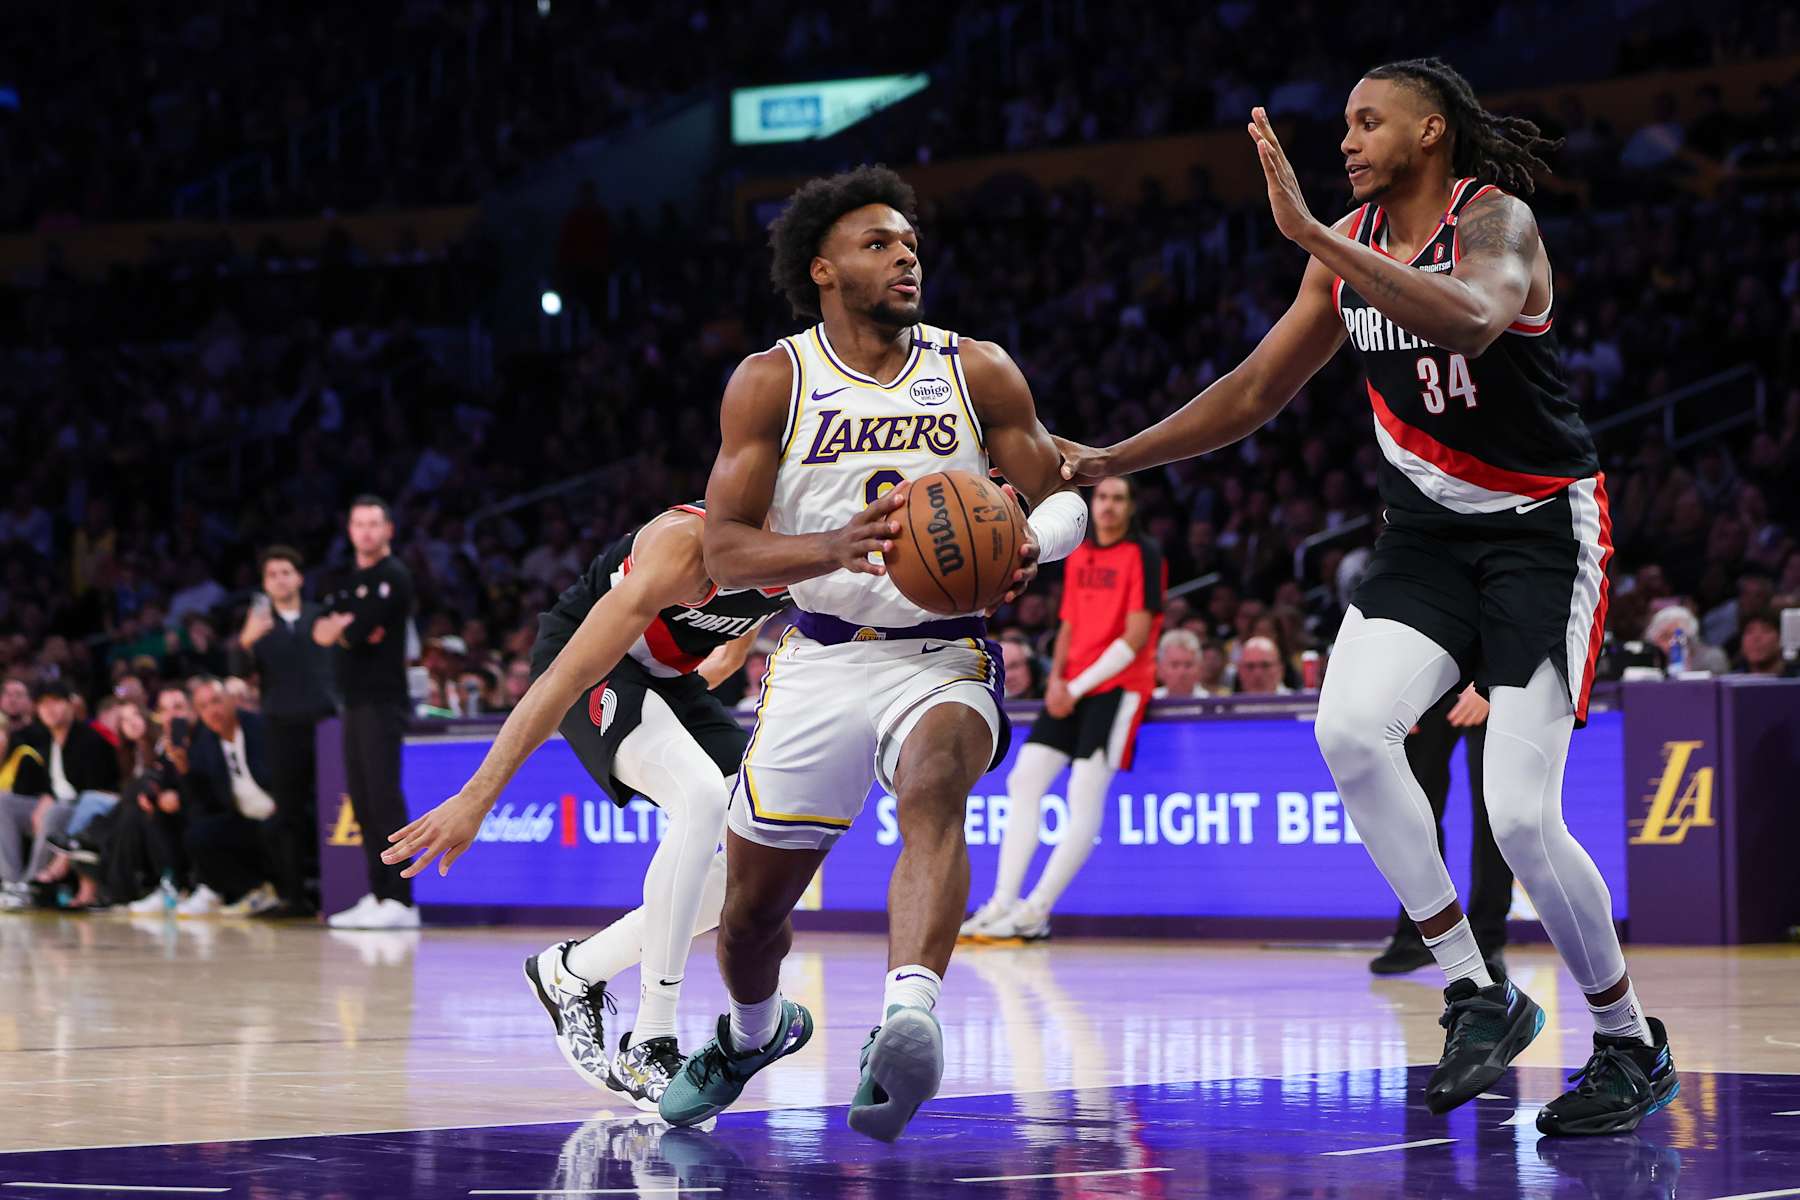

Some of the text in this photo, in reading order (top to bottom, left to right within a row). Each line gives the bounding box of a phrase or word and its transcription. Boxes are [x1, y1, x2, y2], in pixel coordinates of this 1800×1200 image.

[913, 385, 949, 397] bibigo
[1416, 353, 1477, 414] 34
[801, 408, 959, 464] LAKERS
[926, 482, 965, 577] Wilson
[1118, 792, 1261, 845] LIGHT
[1276, 791, 1363, 845] BE
[1628, 740, 1716, 845] LA
[583, 800, 671, 844] ULT
